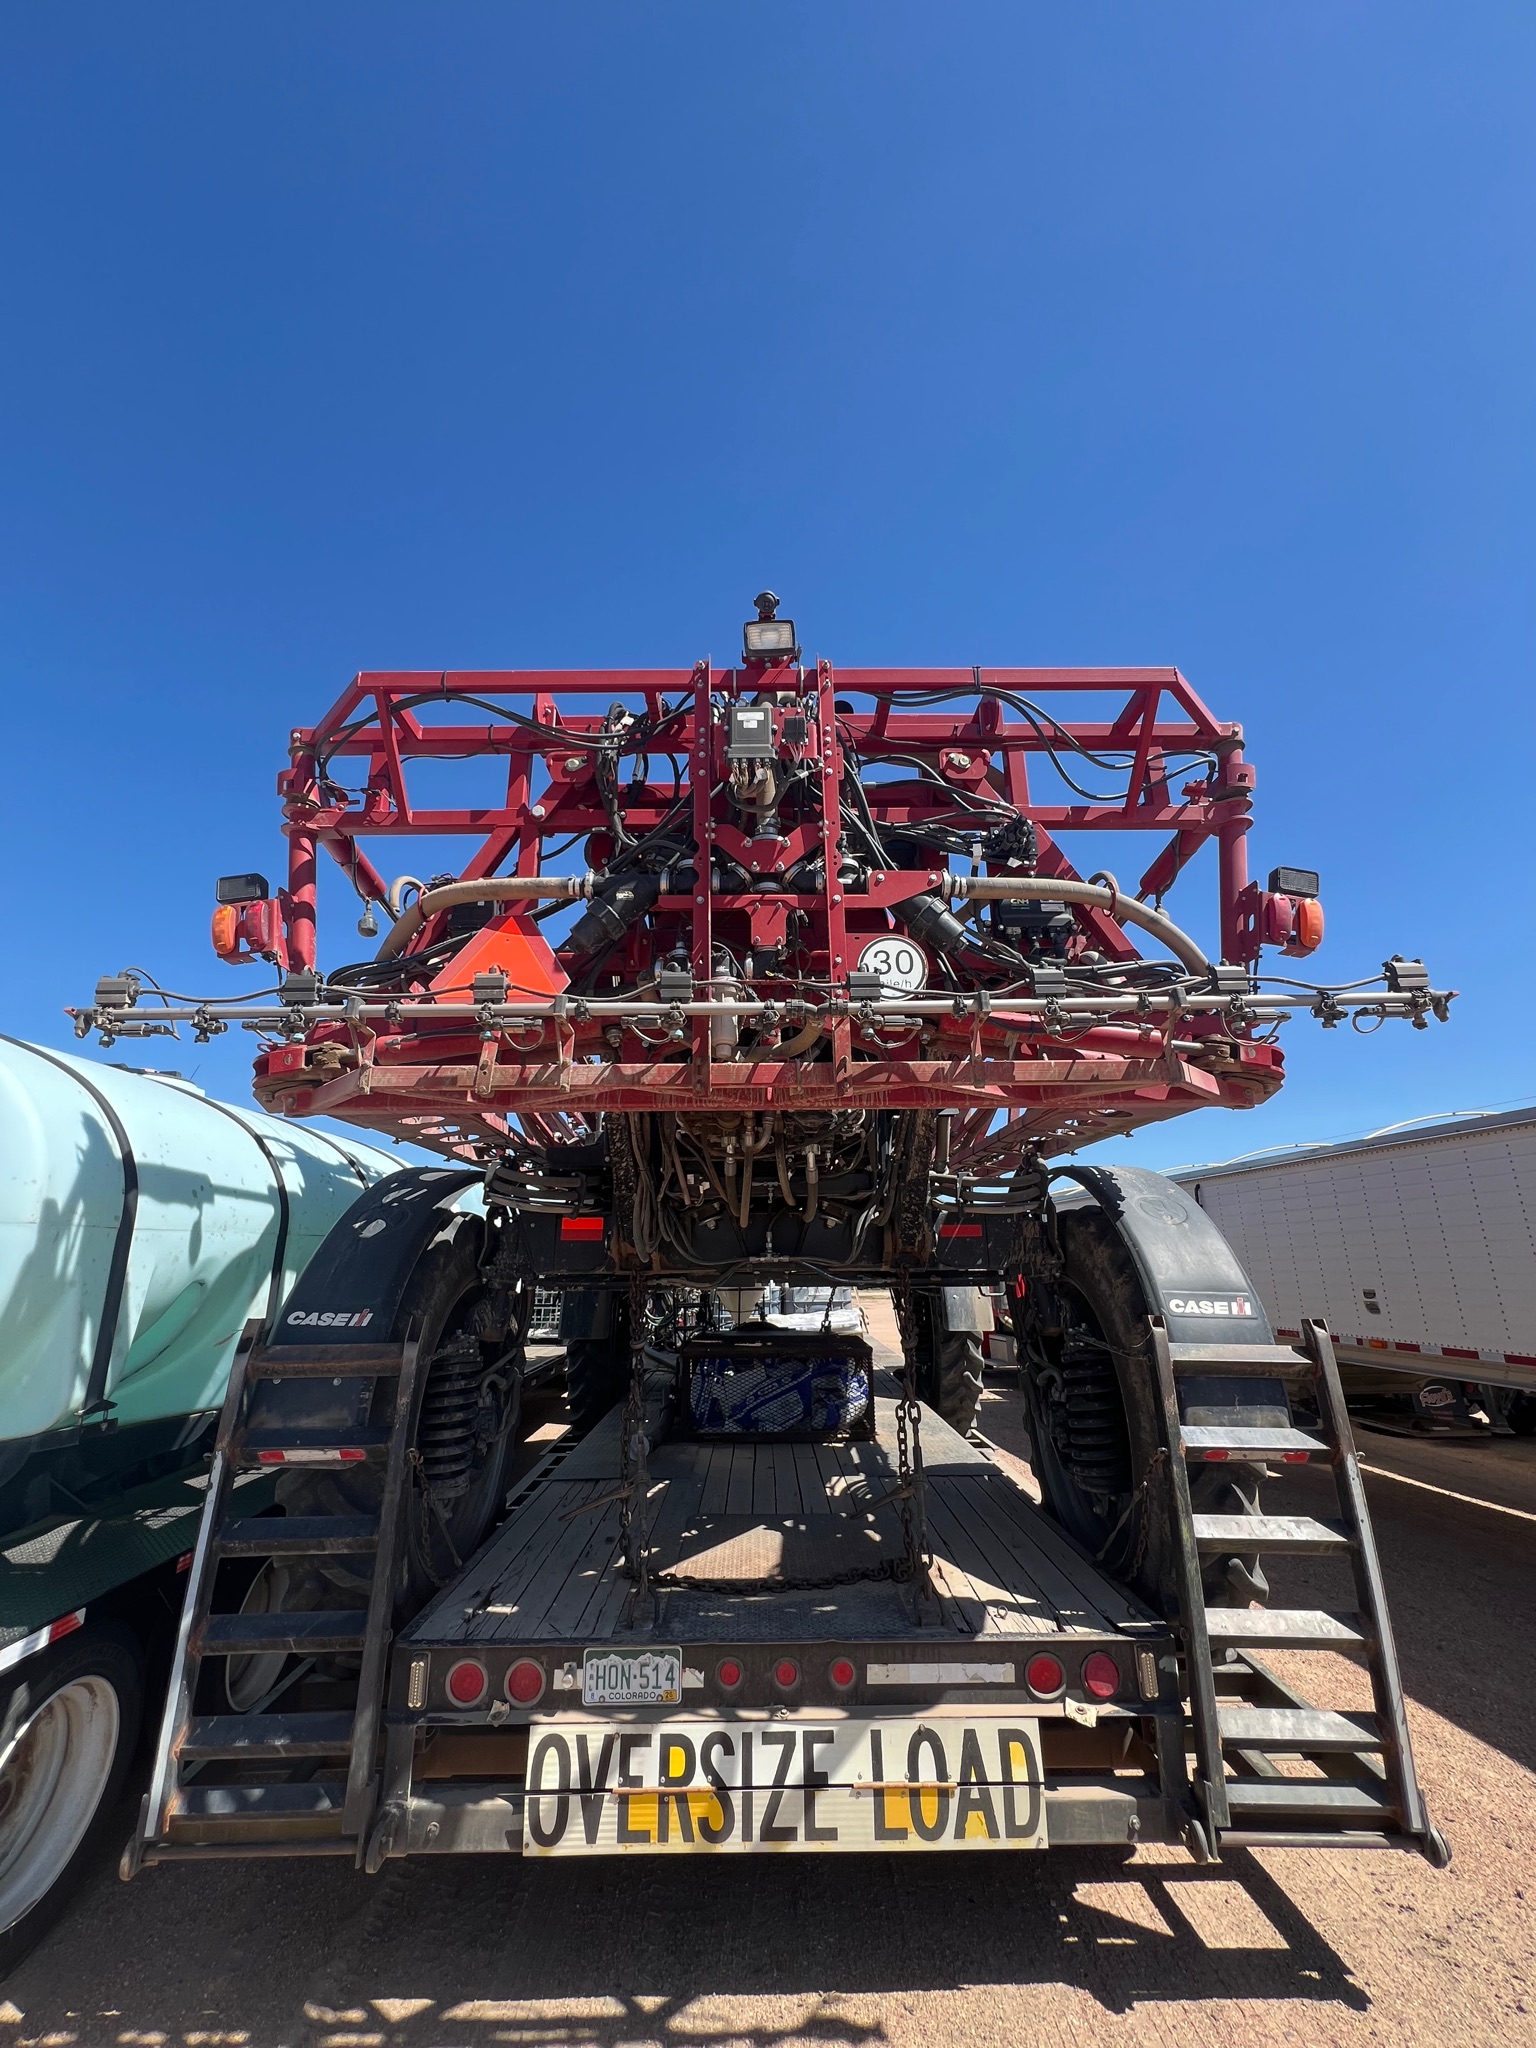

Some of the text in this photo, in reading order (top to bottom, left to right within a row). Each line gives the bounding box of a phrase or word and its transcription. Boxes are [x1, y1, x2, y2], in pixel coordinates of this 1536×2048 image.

[873, 949, 914, 975] 30
[1169, 1298, 1229, 1315] CASE
[608, 1691, 656, 1700] COLORADO
[528, 1727, 1042, 1849] OVERSIZE LOAD
